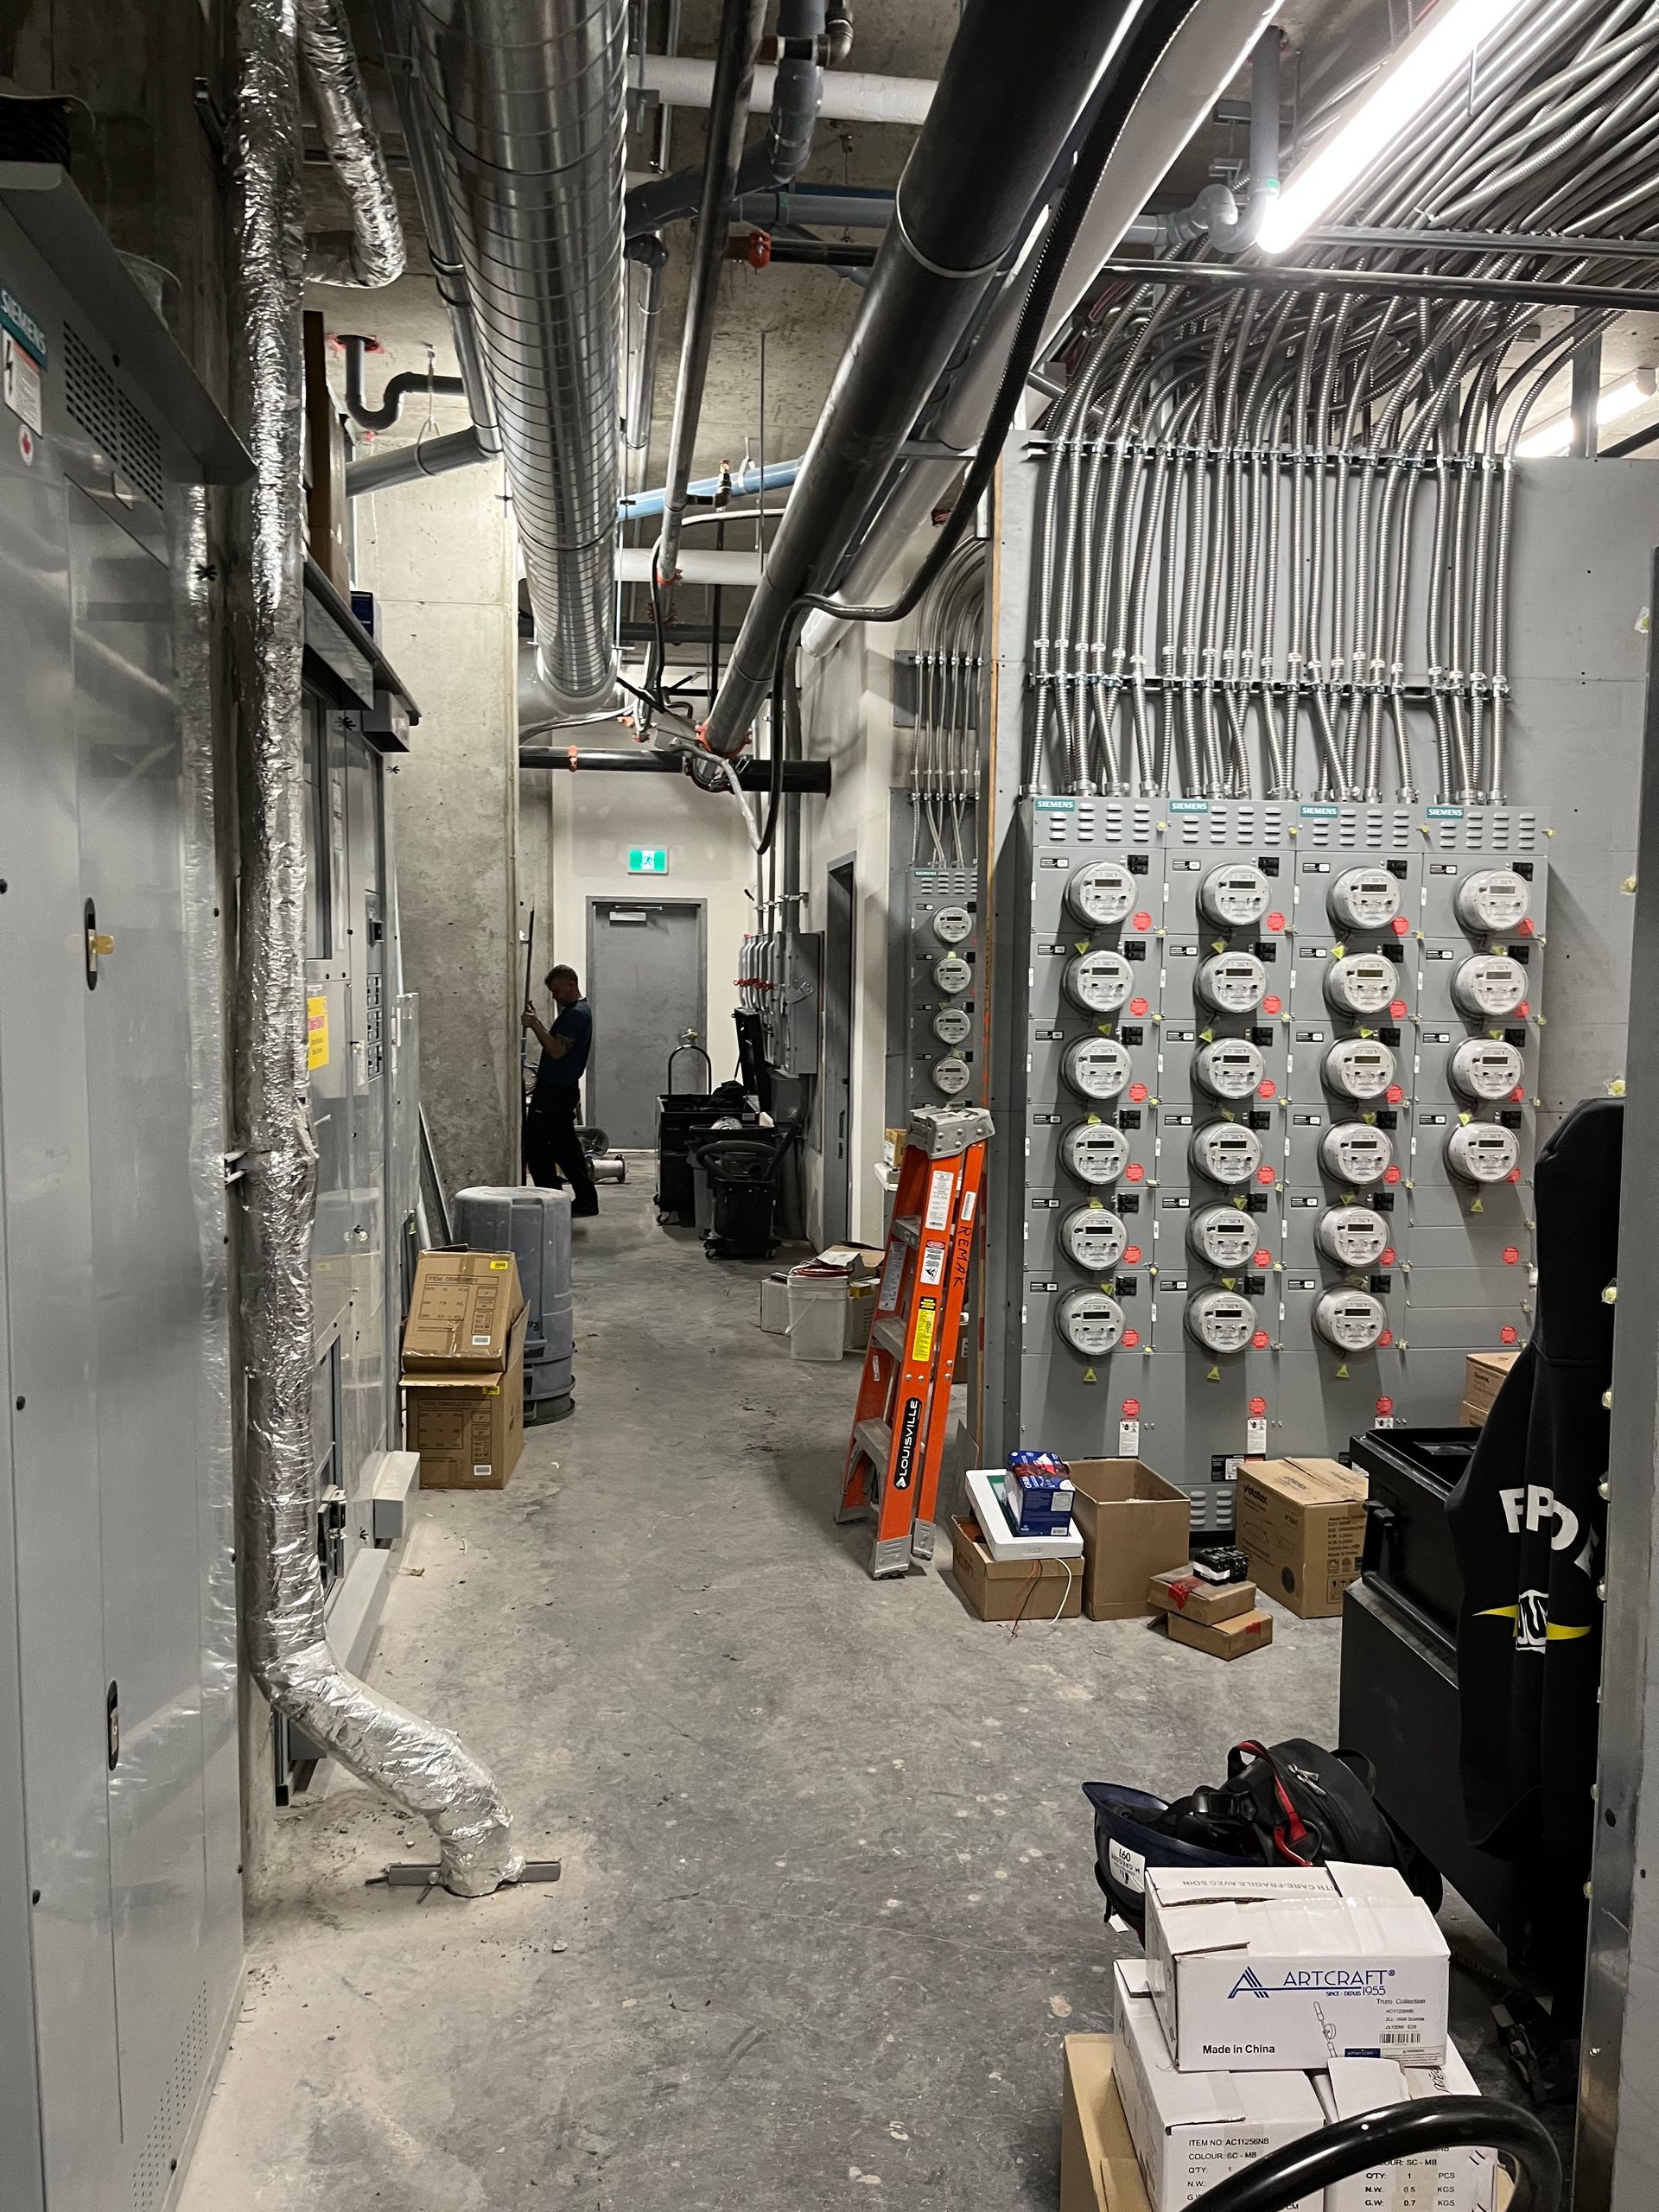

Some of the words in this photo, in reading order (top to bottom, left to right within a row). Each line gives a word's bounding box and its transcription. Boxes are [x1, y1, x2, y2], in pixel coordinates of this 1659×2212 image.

[1037, 800, 1074, 809] SIEMENS
[1172, 802, 1208, 810] SIEMENS
[1301, 806, 1338, 815] SIEMENS
[1427, 808, 1463, 817] SIEMENS
[953, 1225, 971, 1287] REMAK
[899, 1400, 918, 1477] LOUISVILLE
[1363, 1986, 1386, 1996] 1955
[1203, 2044, 1231, 2055] Made
[1233, 2044, 1243, 2054] in
[1245, 2044, 1275, 2054] China
[1225, 2138, 1269, 2146] AC11256NB
